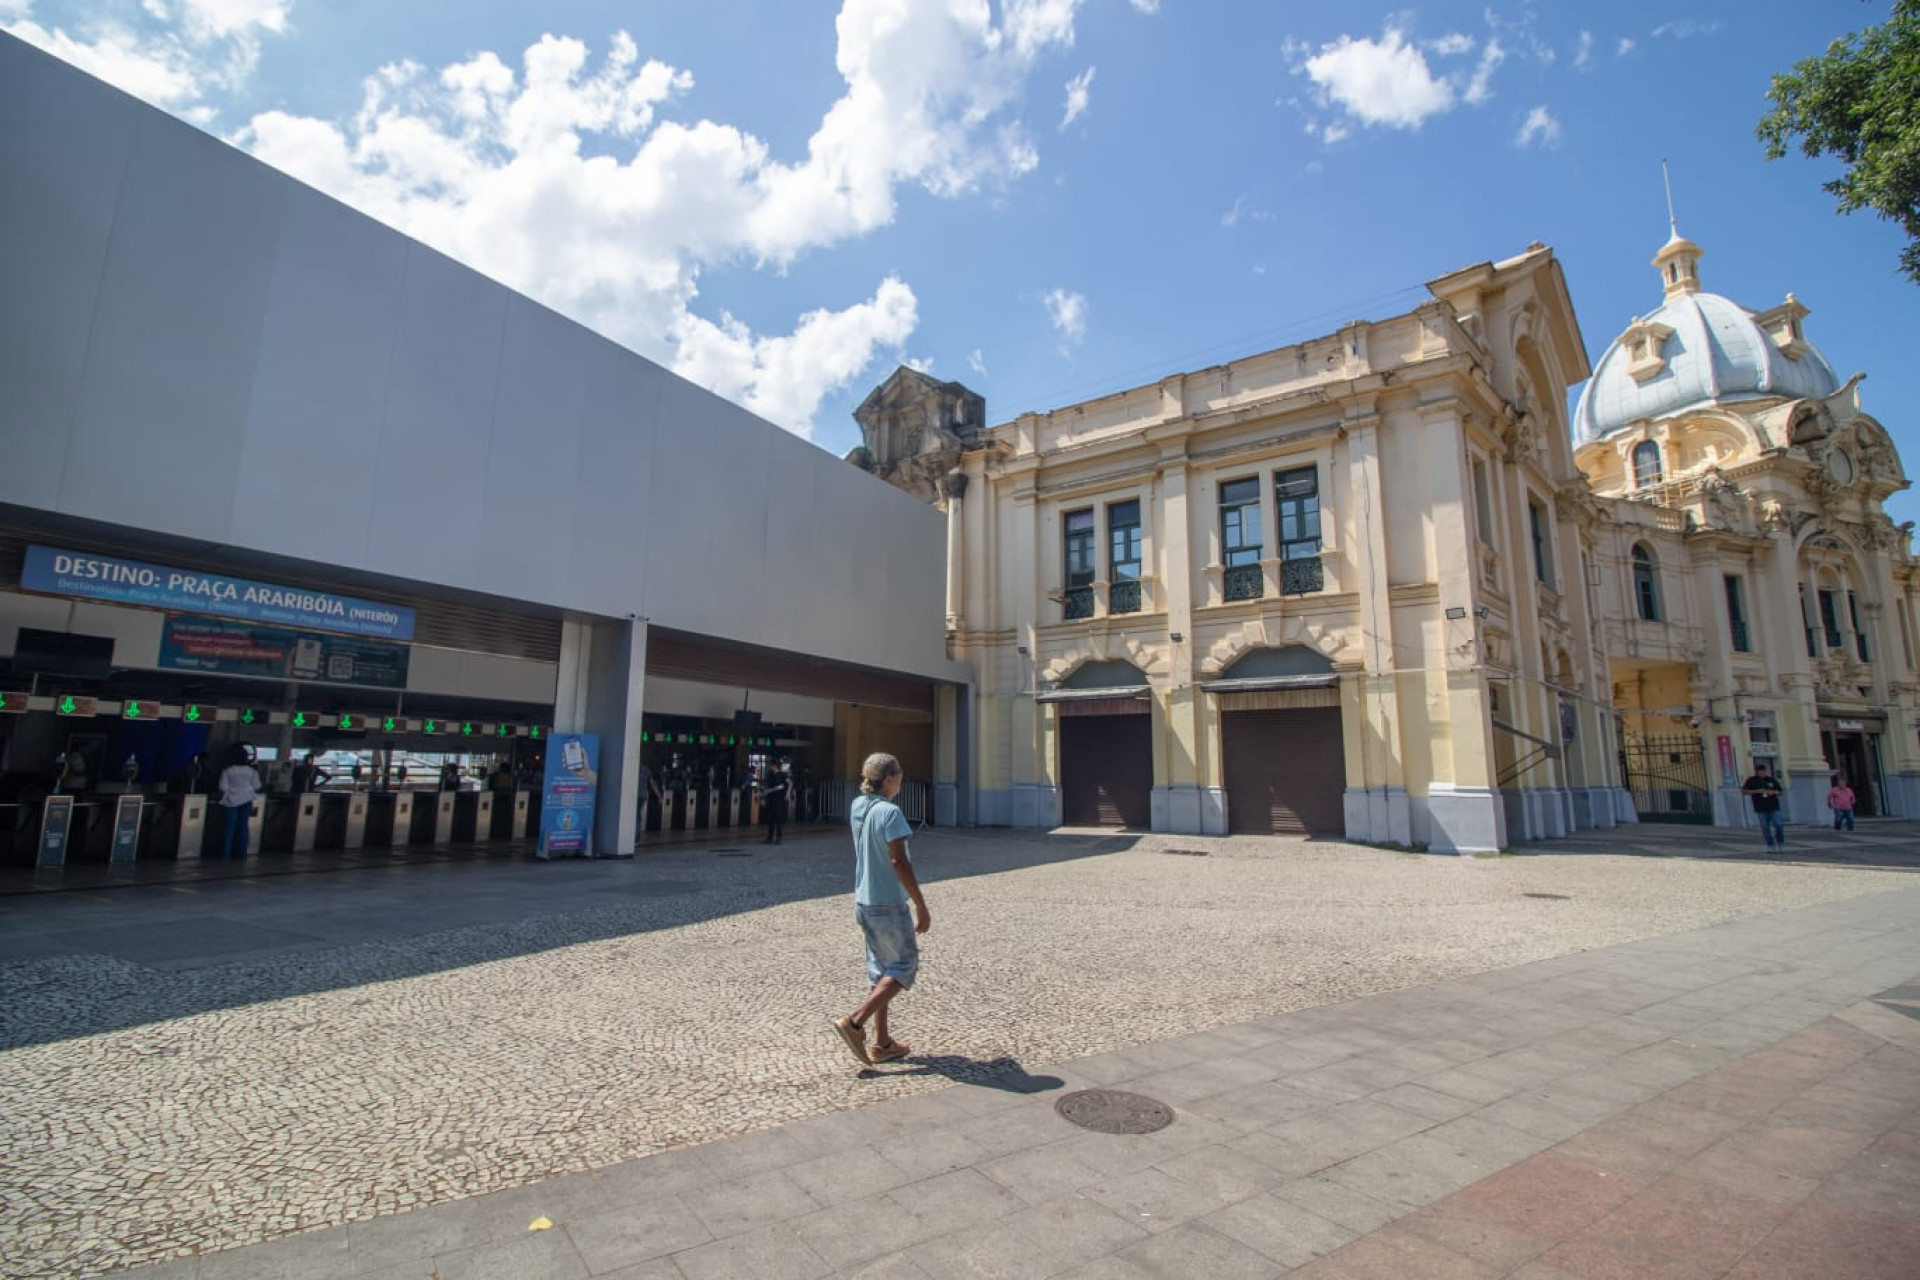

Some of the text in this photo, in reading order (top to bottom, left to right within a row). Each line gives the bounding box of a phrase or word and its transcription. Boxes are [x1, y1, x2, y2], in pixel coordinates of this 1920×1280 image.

[54, 555, 161, 588] DESTINO:
[168, 573, 238, 601] PRAÇA
[243, 586, 345, 616] ARARIBÓIA
